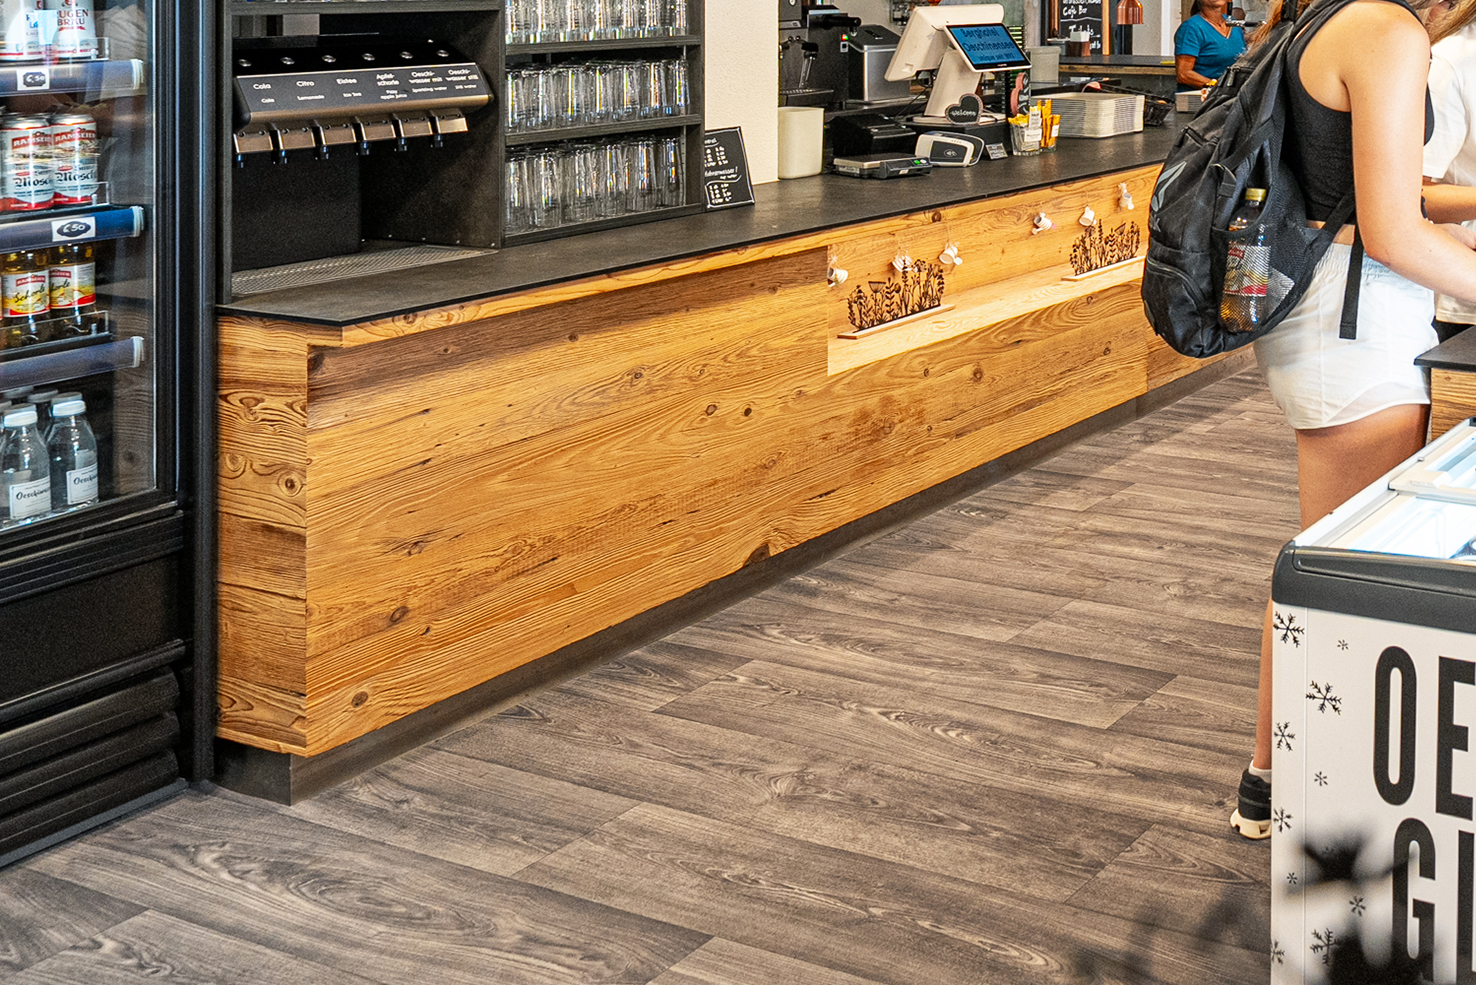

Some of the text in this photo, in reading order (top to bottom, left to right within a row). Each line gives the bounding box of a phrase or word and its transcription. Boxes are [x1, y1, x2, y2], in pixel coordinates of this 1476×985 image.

[1078, 5, 1088, 14] Bar
[960, 27, 999, 38] Berghotel
[962, 41, 1015, 52] Oeschinensee
[411, 70, 435, 78] Oeschi-
[448, 68, 471, 76] Oeschi-
[296, 80, 315, 88] Citro
